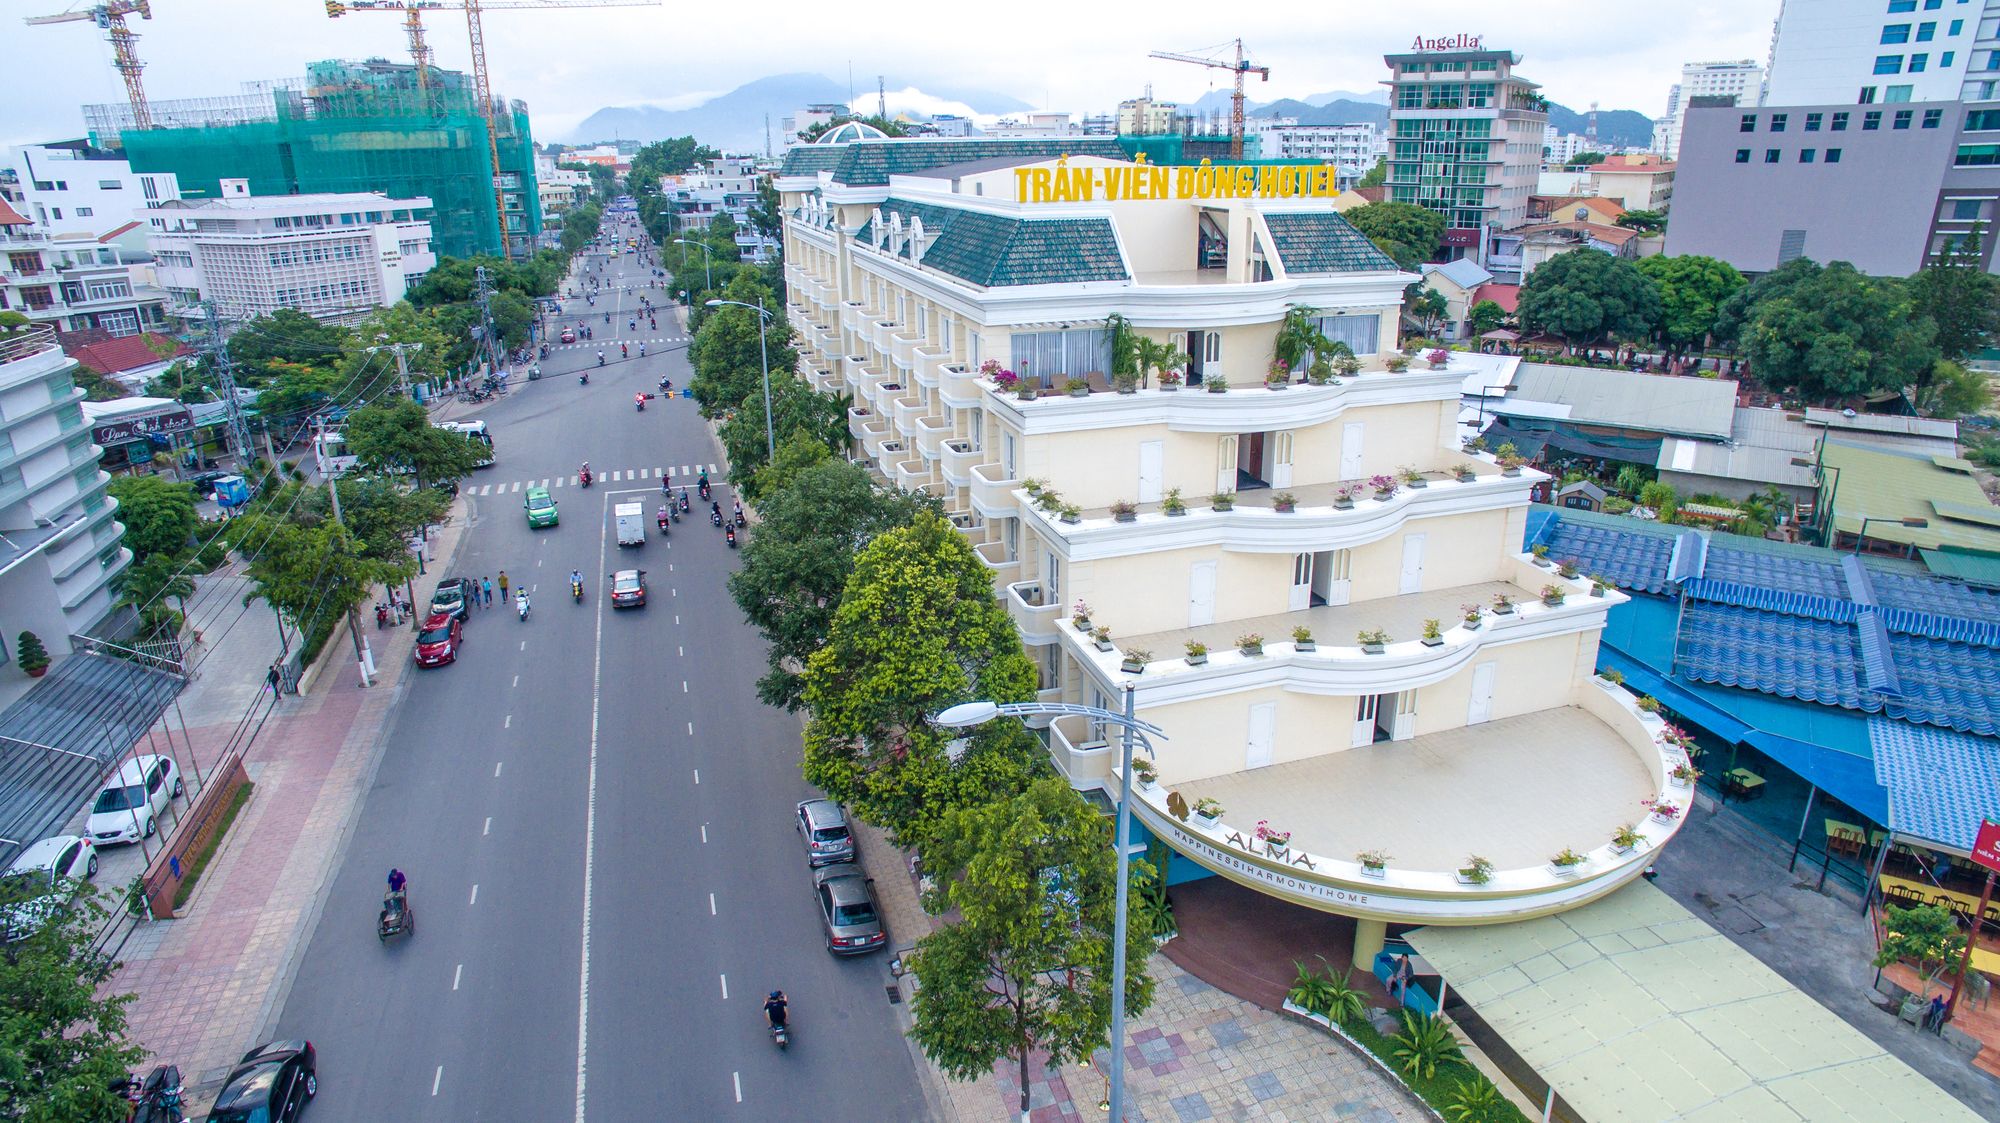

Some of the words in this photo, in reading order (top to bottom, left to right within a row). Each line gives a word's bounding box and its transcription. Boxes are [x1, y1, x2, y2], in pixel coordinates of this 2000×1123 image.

[1411, 33, 1479, 51] Angella
[1176, 157, 1255, 199] ĐÔNG
[1259, 165, 1340, 199] HOTEL
[101, 427, 129, 442] Lan
[165, 418, 188, 430] shop
[1225, 832, 1317, 870] ALMA
